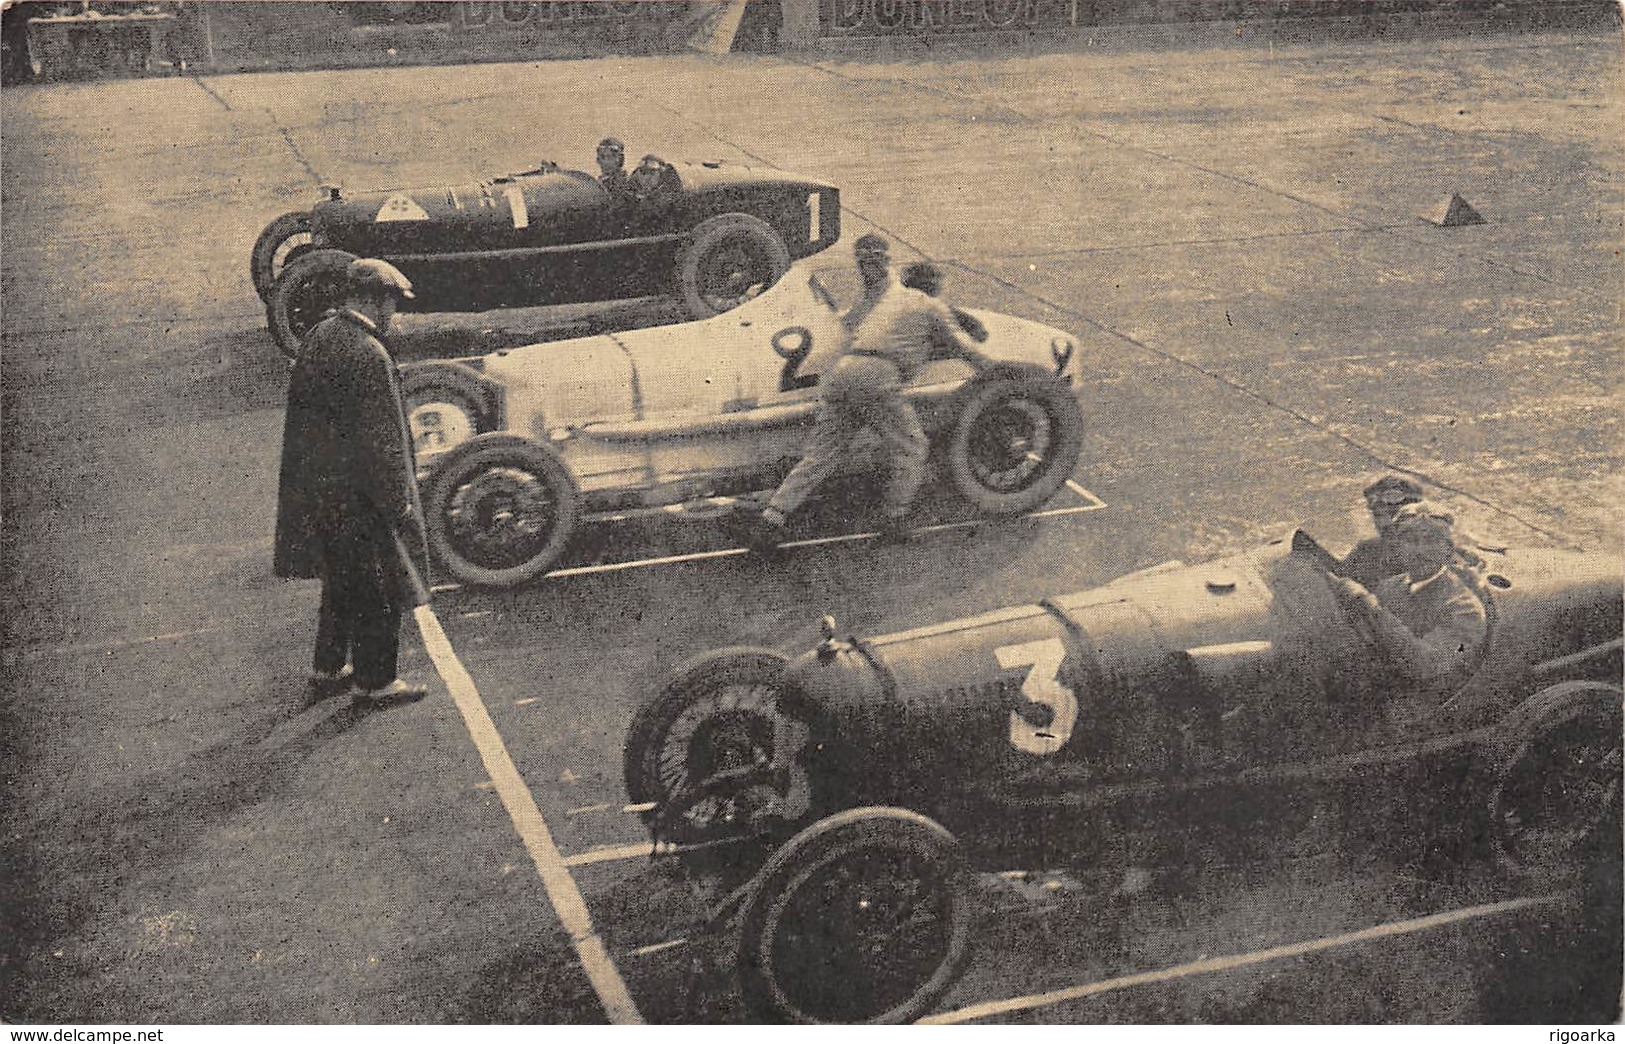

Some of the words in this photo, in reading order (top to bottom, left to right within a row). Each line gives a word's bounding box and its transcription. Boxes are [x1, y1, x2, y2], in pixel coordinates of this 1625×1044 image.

[502, 187, 529, 229] 1
[806, 193, 820, 241] 1
[771, 326, 820, 393] 2
[992, 637, 1079, 756] 3
